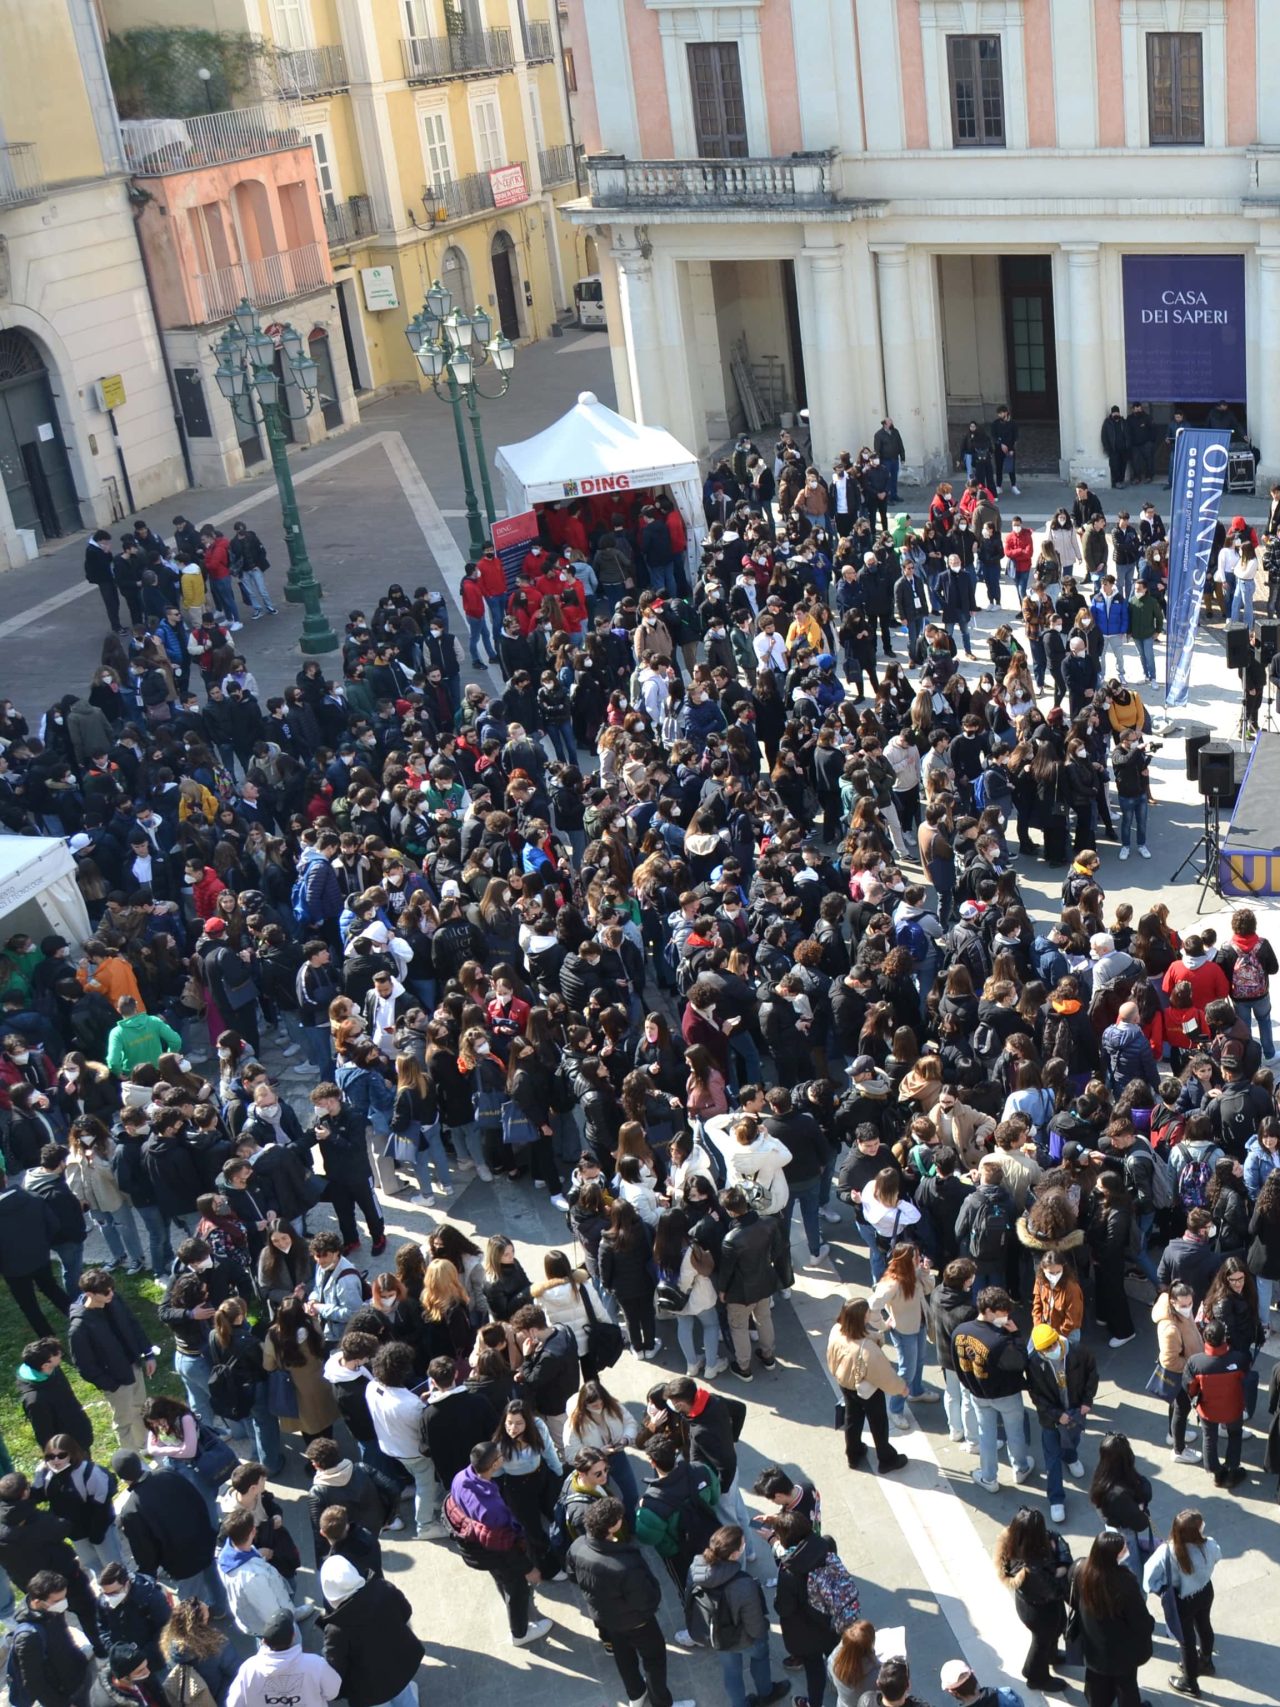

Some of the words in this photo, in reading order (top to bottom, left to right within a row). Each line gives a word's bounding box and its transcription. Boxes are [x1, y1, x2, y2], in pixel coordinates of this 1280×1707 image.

[1161, 290, 1208, 305] CASA
[1141, 309, 1168, 324] DEI
[1172, 309, 1228, 324] SAPERI
[580, 475, 630, 494] DING
